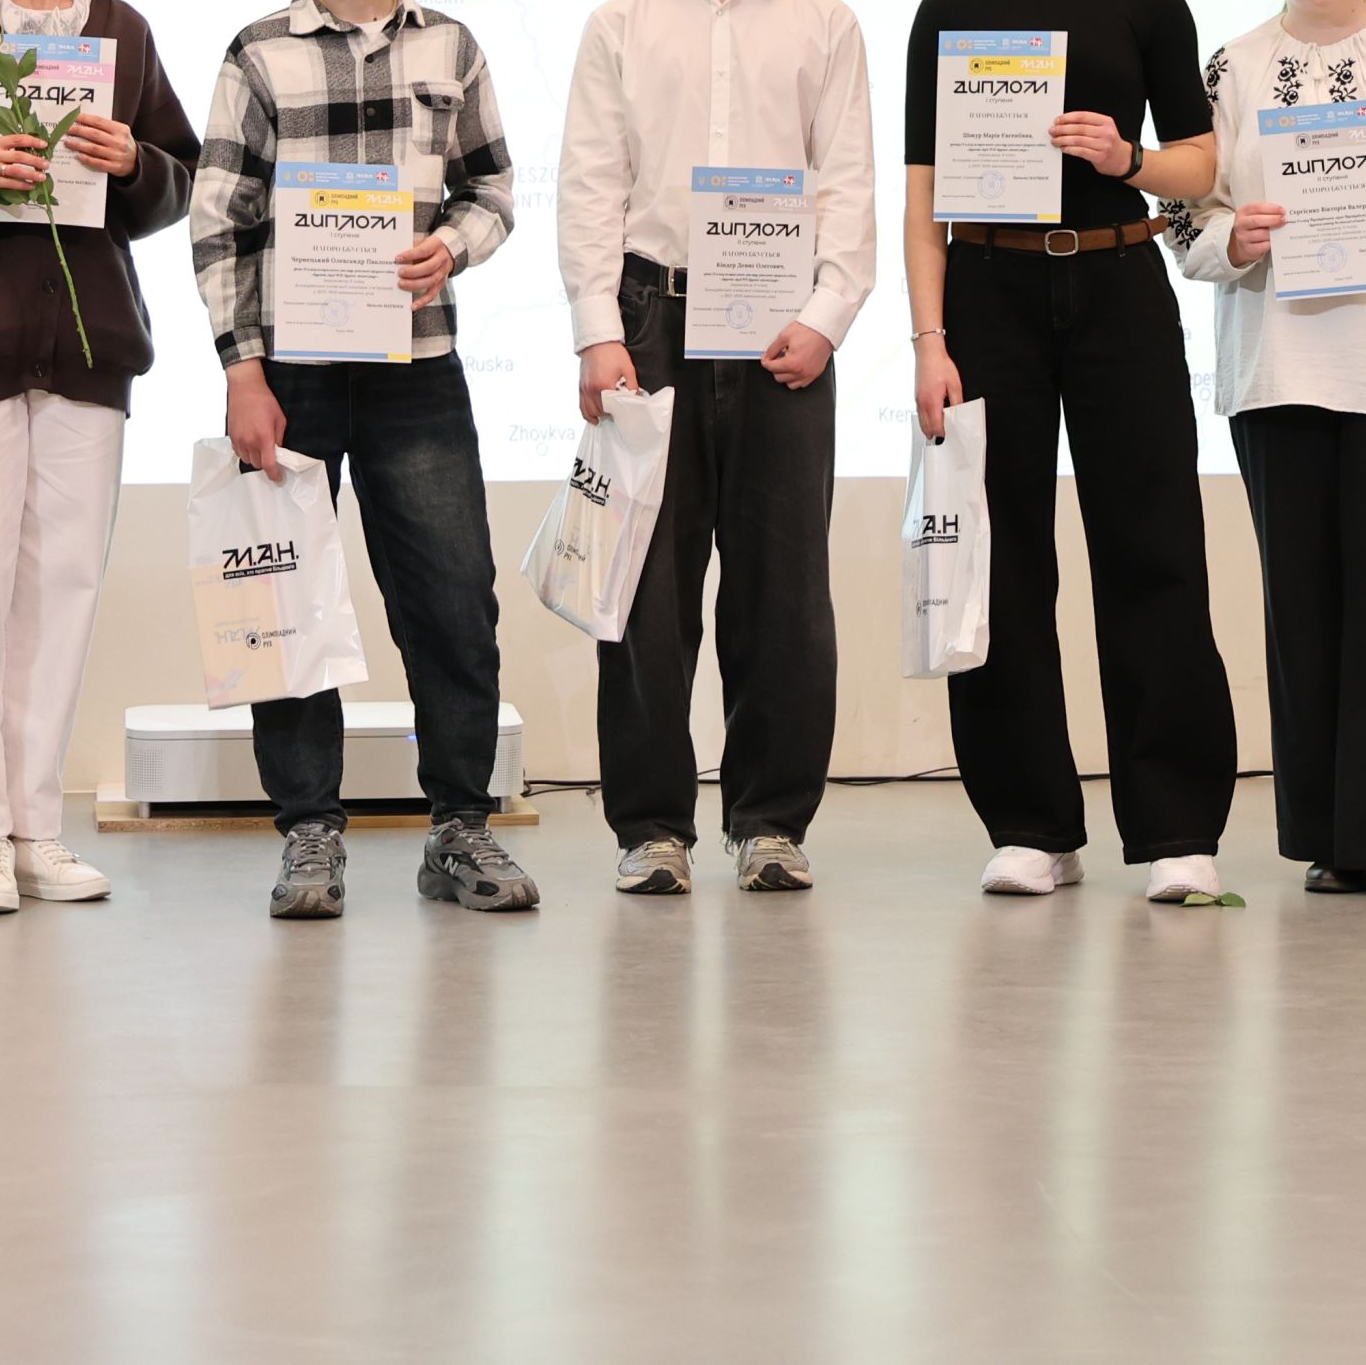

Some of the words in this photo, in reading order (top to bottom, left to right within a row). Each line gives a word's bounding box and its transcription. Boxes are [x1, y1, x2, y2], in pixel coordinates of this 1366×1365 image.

[953, 80, 1048, 96] ДИПЛОМ
[517, 167, 560, 183] ESZO
[294, 213, 397, 231] ДИПЛОМ
[706, 221, 800, 238] ДИПЛОМ
[507, 424, 576, 443] Zhovkva
[222, 540, 300, 569] М.А.Н.
